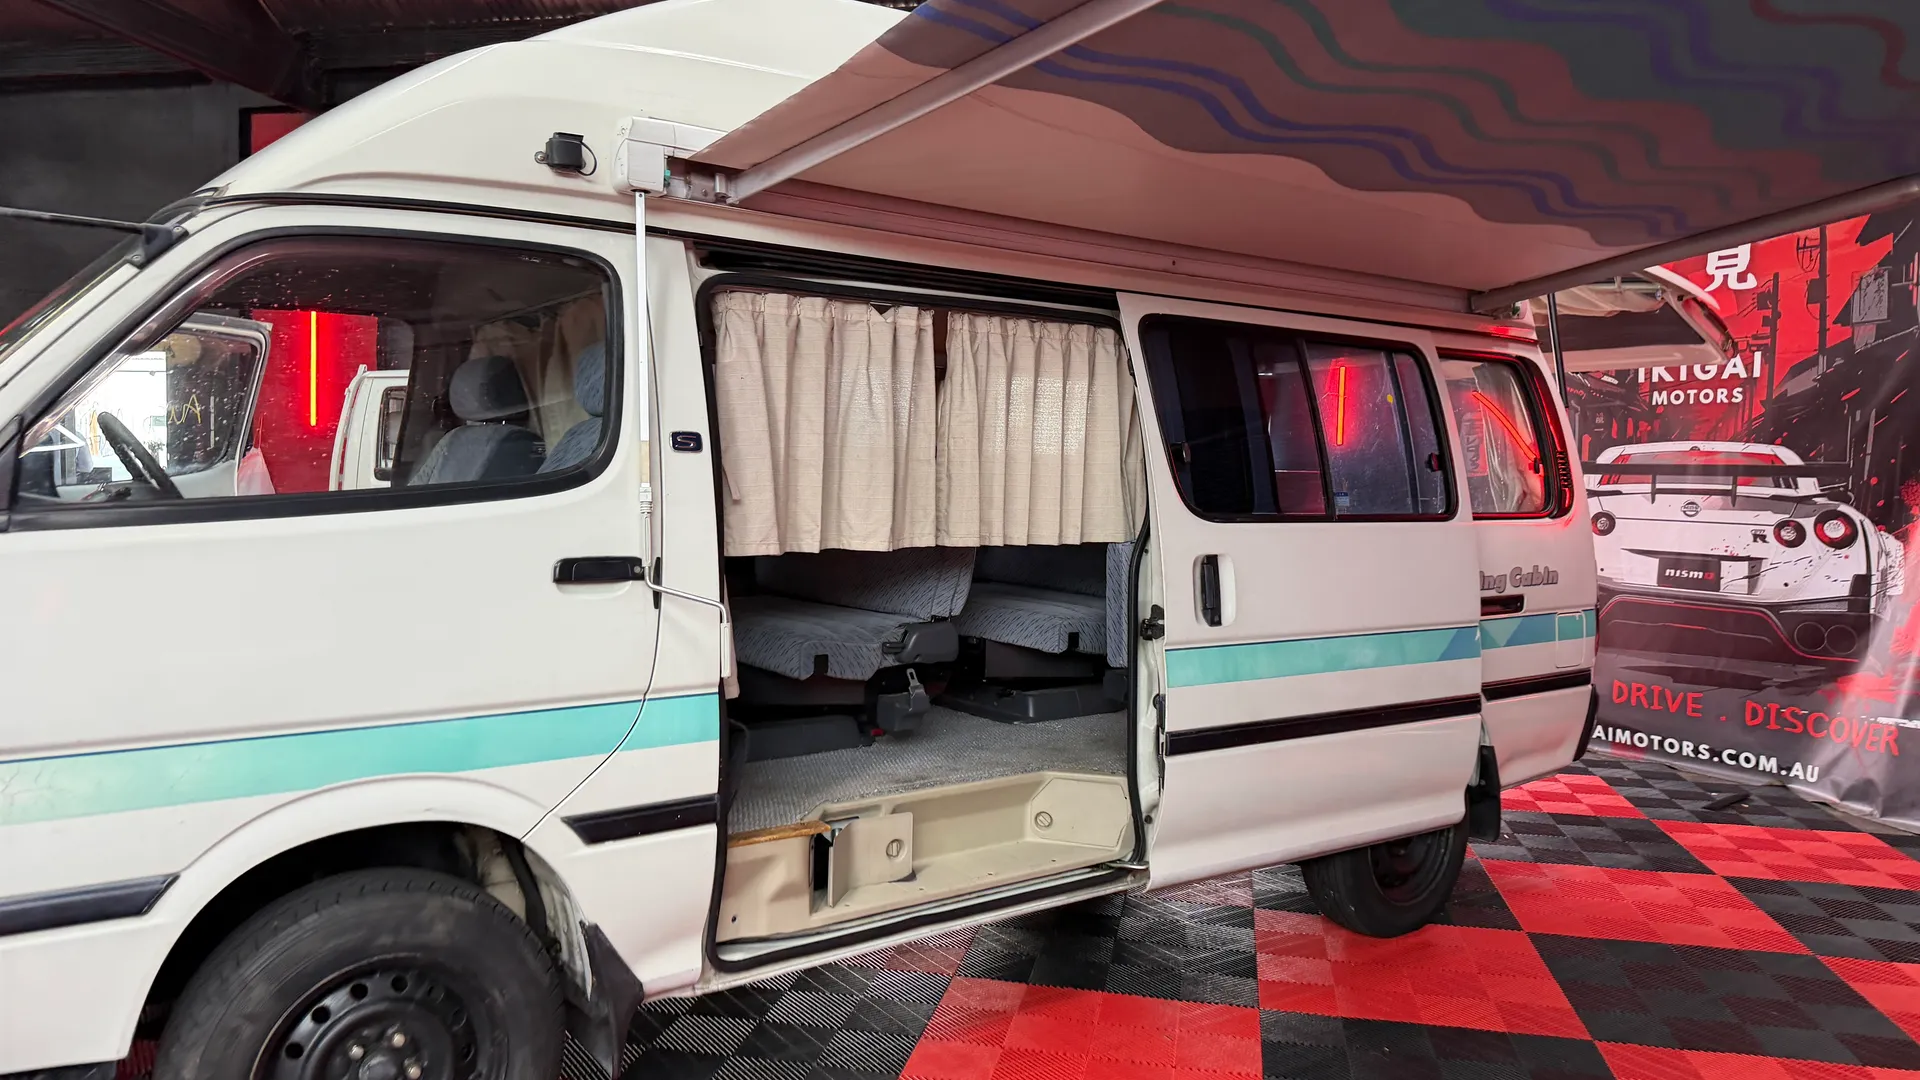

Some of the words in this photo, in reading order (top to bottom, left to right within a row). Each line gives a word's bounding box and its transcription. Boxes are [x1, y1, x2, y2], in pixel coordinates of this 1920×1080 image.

[1704, 243, 1758, 292] 見
[1638, 351, 1762, 383] IKIGAI
[1651, 387, 1744, 406] MOTORS
[1509, 565, 1559, 588] Cabin
[1612, 679, 1704, 718] DRIVE
[1745, 699, 1900, 757] DISCOVER
[1592, 725, 1820, 783] AIMOTORS.COM.AU
